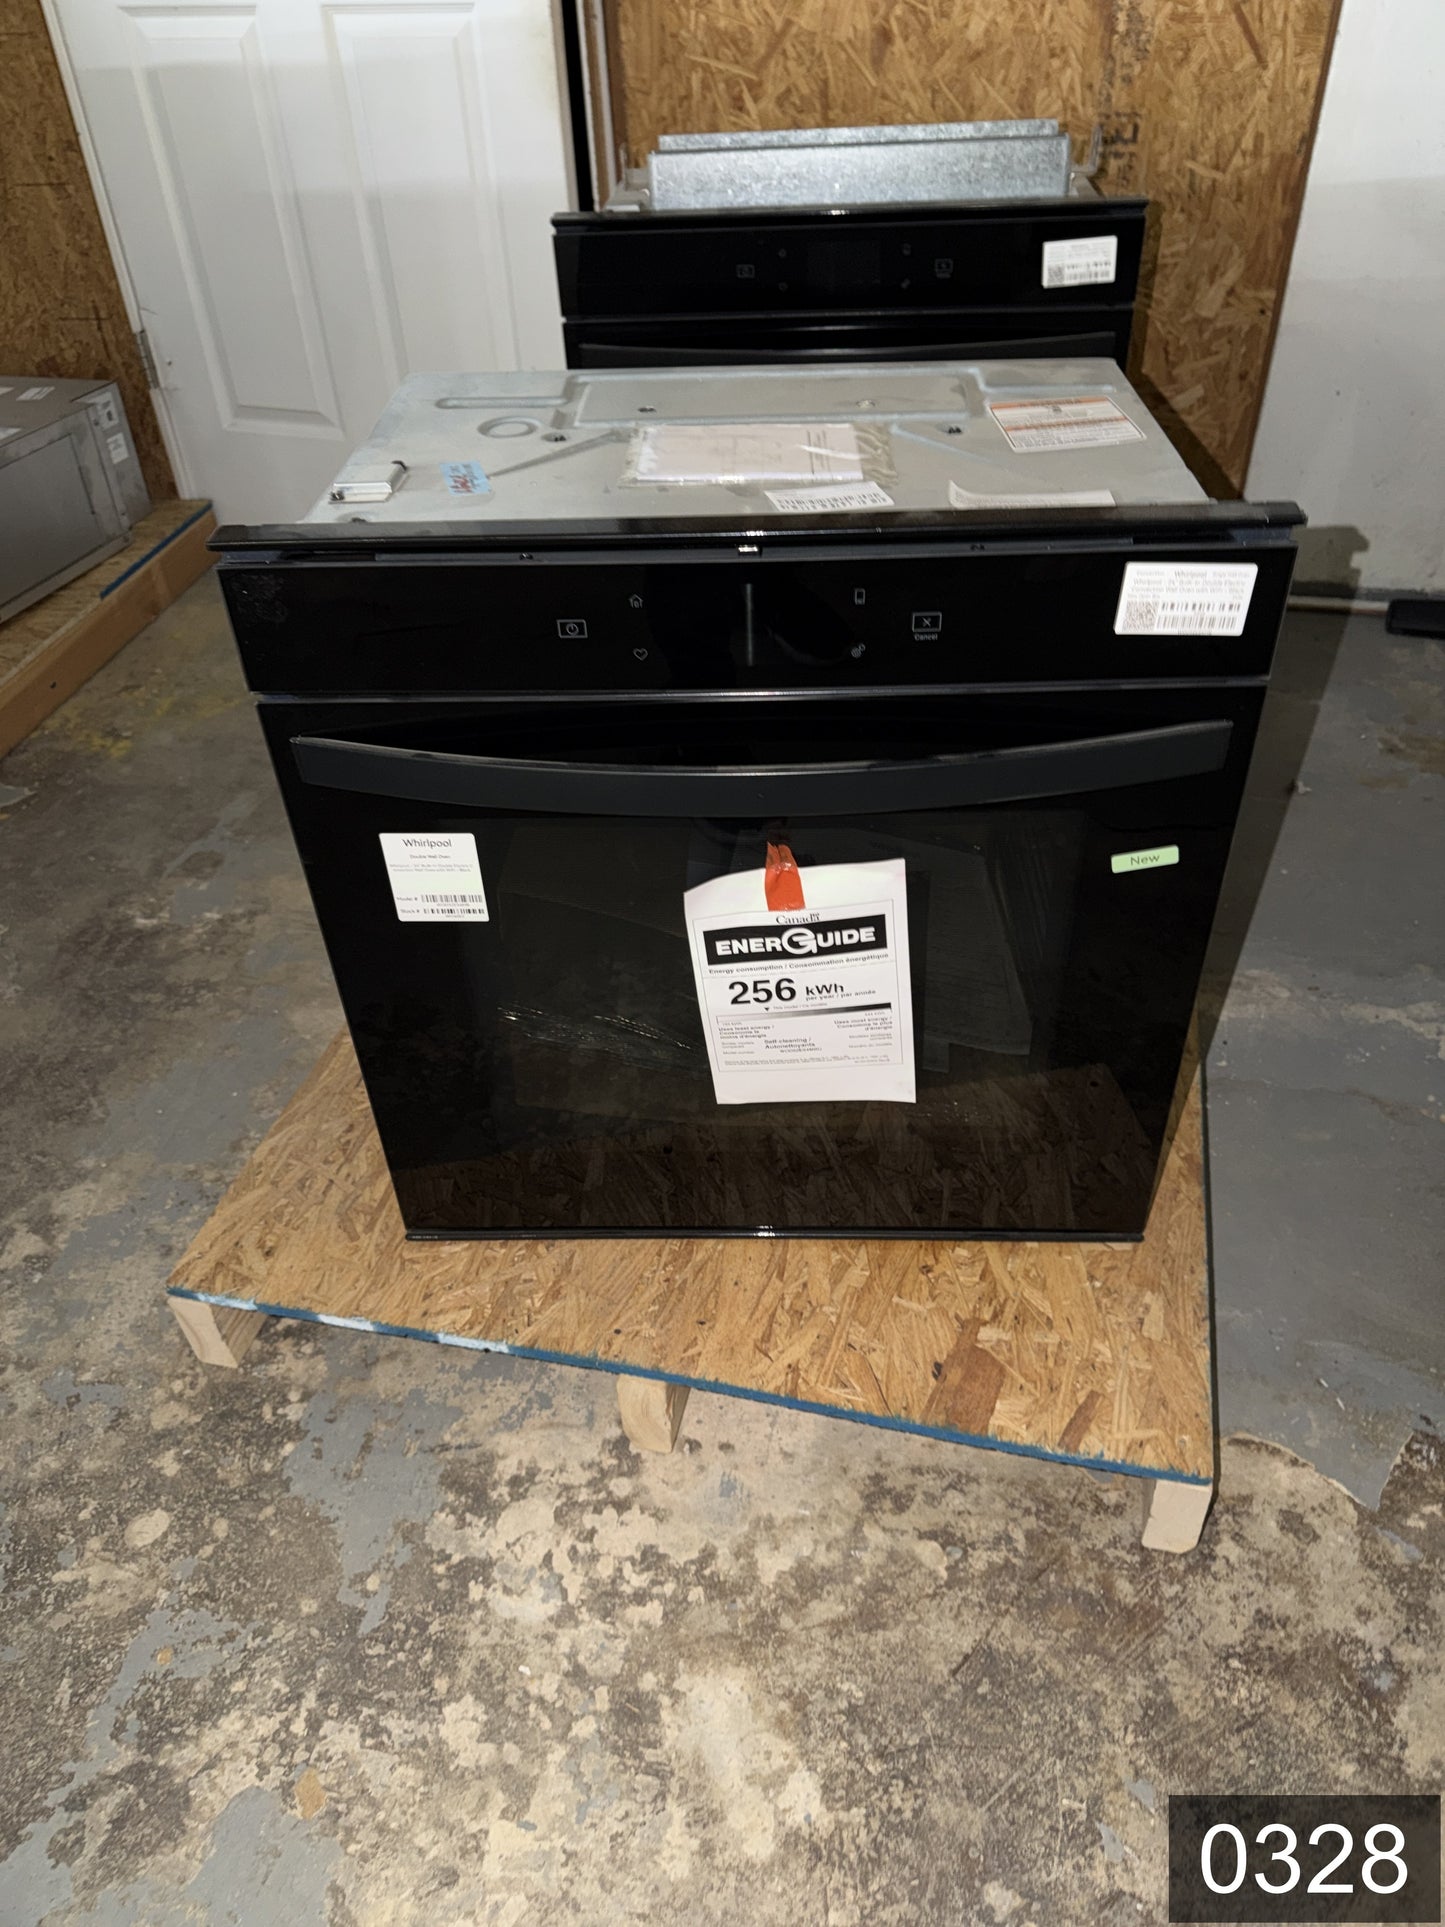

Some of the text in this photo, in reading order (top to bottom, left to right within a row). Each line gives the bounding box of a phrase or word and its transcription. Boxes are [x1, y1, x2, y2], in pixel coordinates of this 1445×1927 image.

[402, 838, 452, 849] Whirlpool
[1130, 854, 1160, 866] New
[715, 926, 876, 956] ENERGUIDE
[736, 964, 783, 973] consumption
[789, 958, 844, 969] Consommation
[845, 953, 889, 963] énergétique
[728, 977, 797, 1005] 256
[805, 983, 845, 996] kWh
